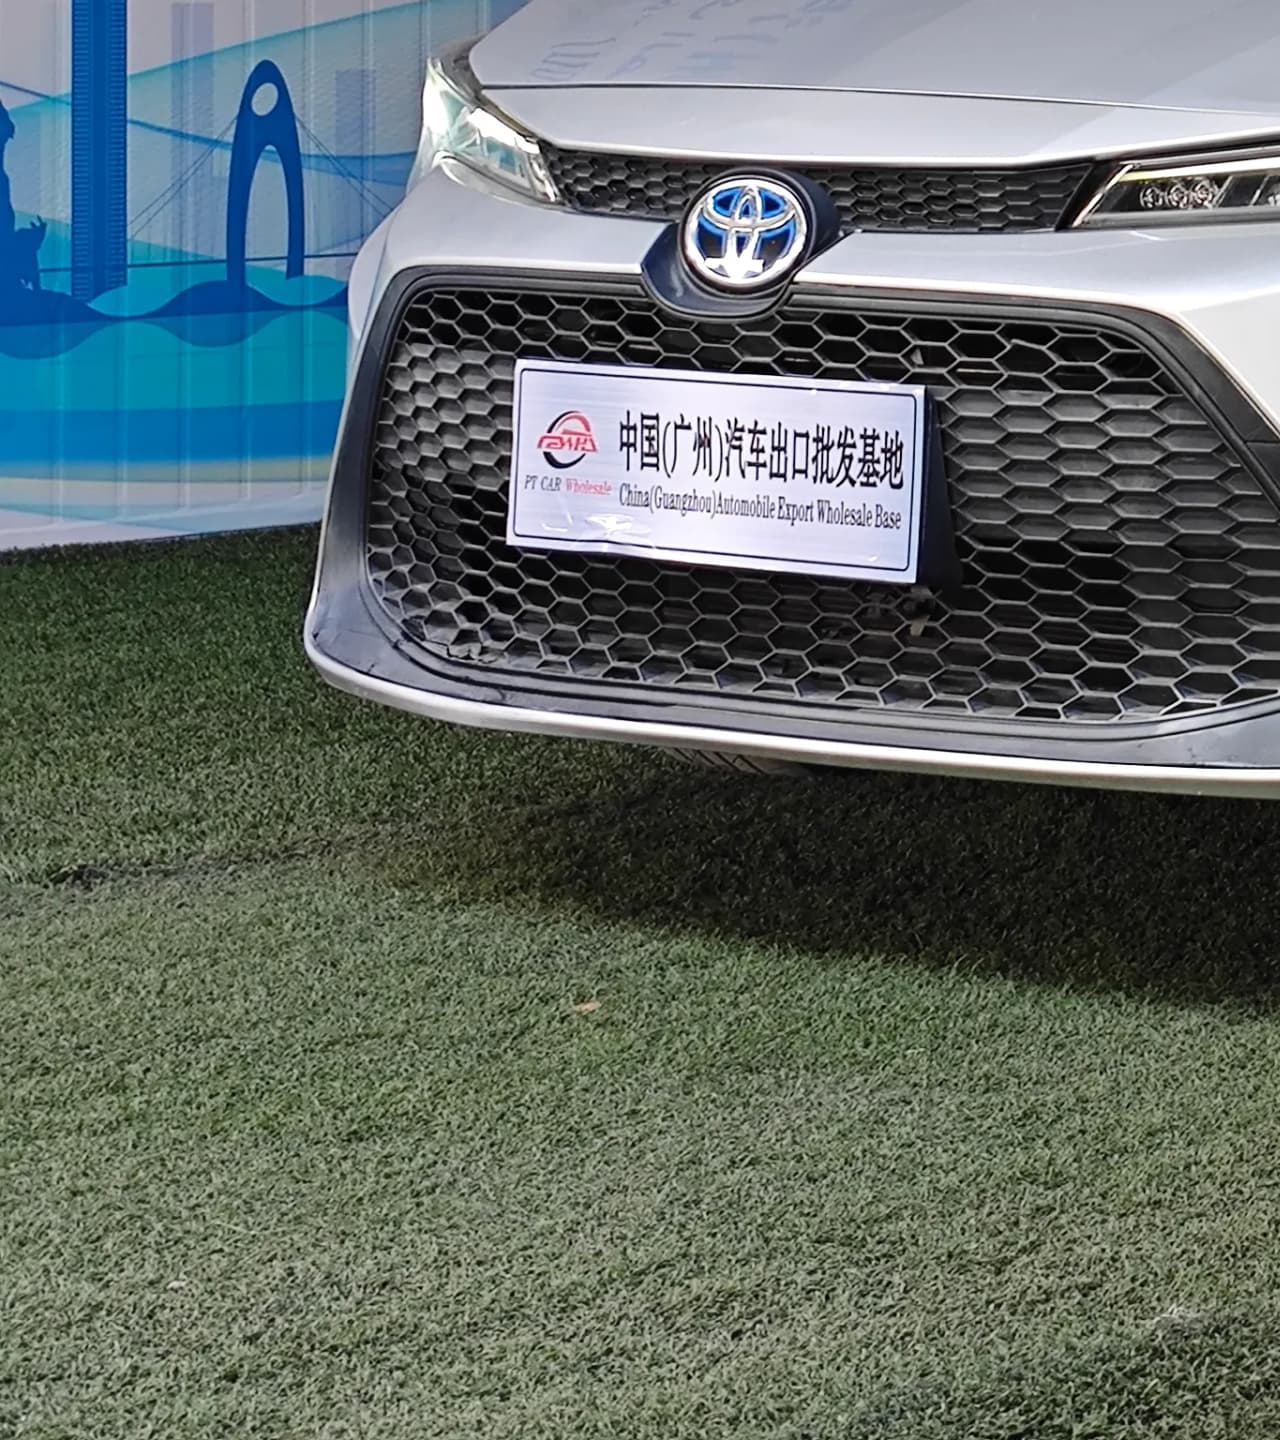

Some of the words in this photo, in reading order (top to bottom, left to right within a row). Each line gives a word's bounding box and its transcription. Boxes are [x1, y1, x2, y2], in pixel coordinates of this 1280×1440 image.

[619, 409, 904, 490] 中国(广州)汽车出口批发基地
[540, 475, 562, 492] CAR
[777, 496, 814, 527] Export
[816, 499, 873, 529] Wholesale
[874, 503, 902, 531] Base
